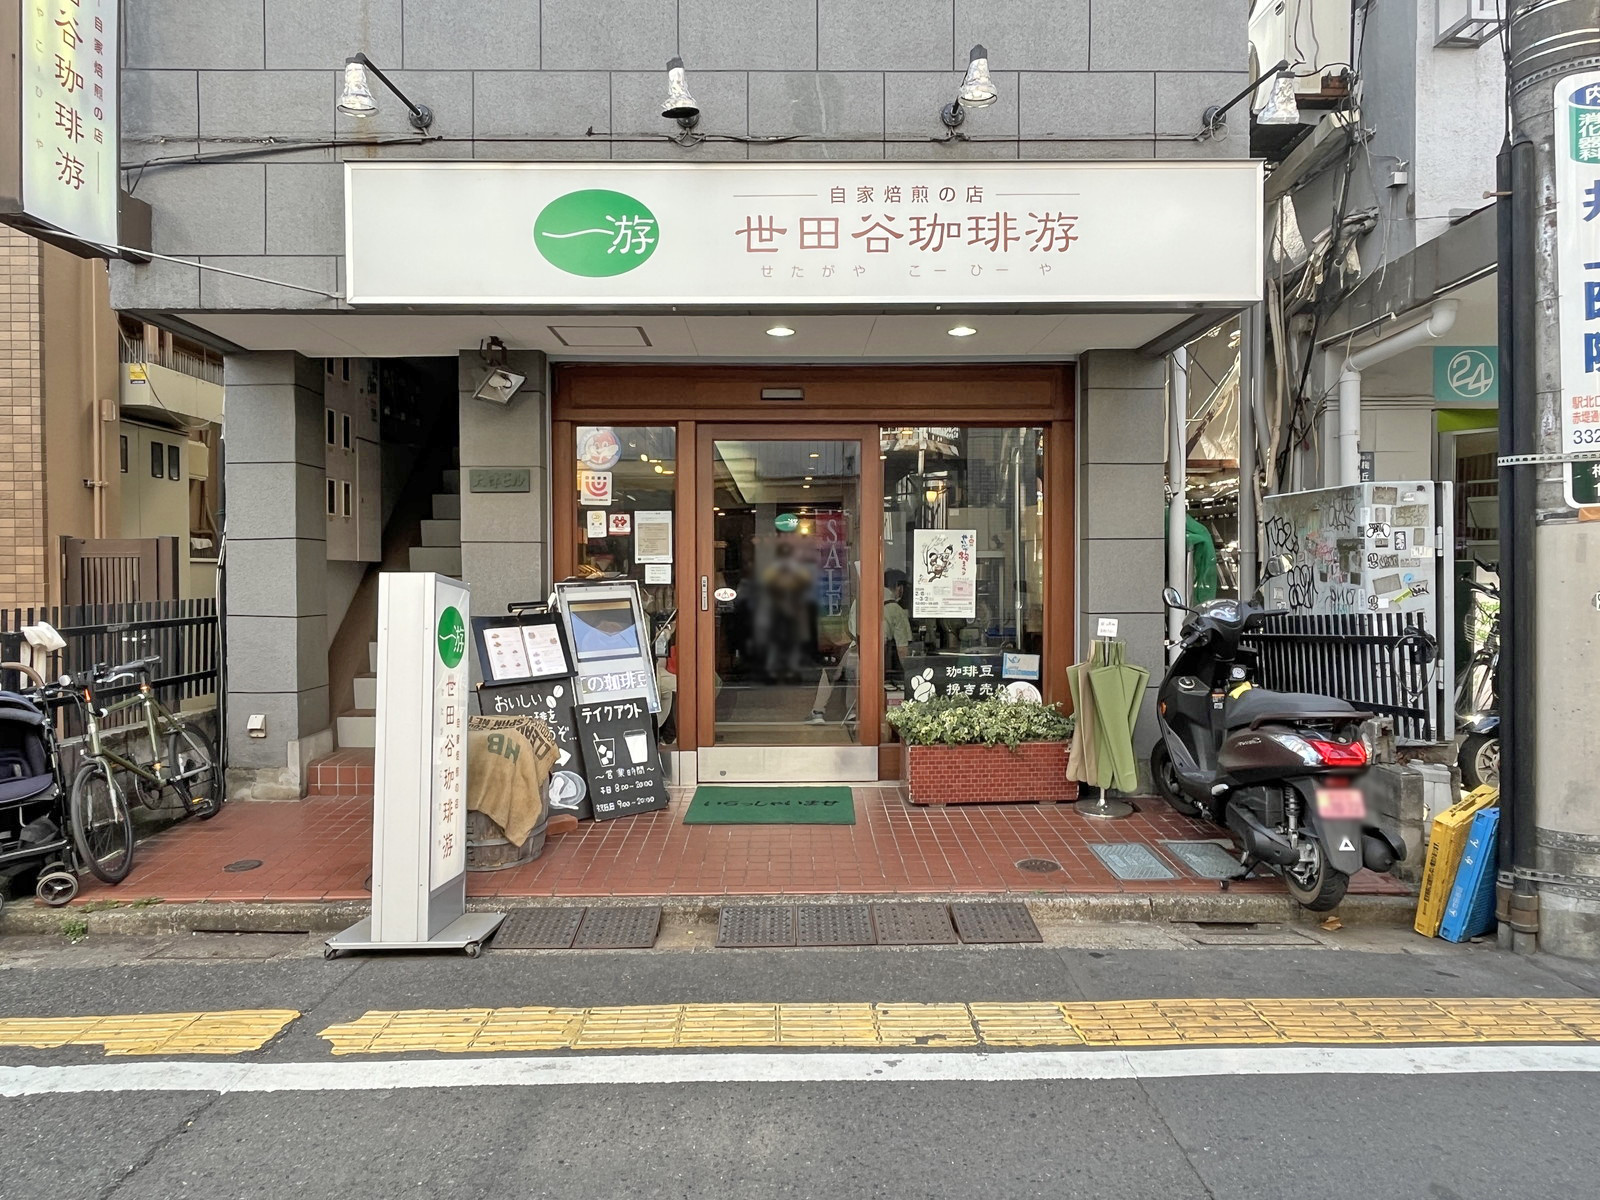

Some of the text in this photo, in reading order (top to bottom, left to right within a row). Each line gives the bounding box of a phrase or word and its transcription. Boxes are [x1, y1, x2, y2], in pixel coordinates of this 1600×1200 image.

[54, 0, 85, 190] 谷珈琲游
[830, 185, 984, 204] 自家焙煎の店
[735, 211, 1080, 254] 世田谷珈琲游
[1452, 355, 1492, 393] 24
[823, 519, 842, 617] SALE
[945, 664, 994, 678] 珈琲豆
[494, 693, 543, 713] おいしい
[581, 702, 644, 724] テイクアウト
